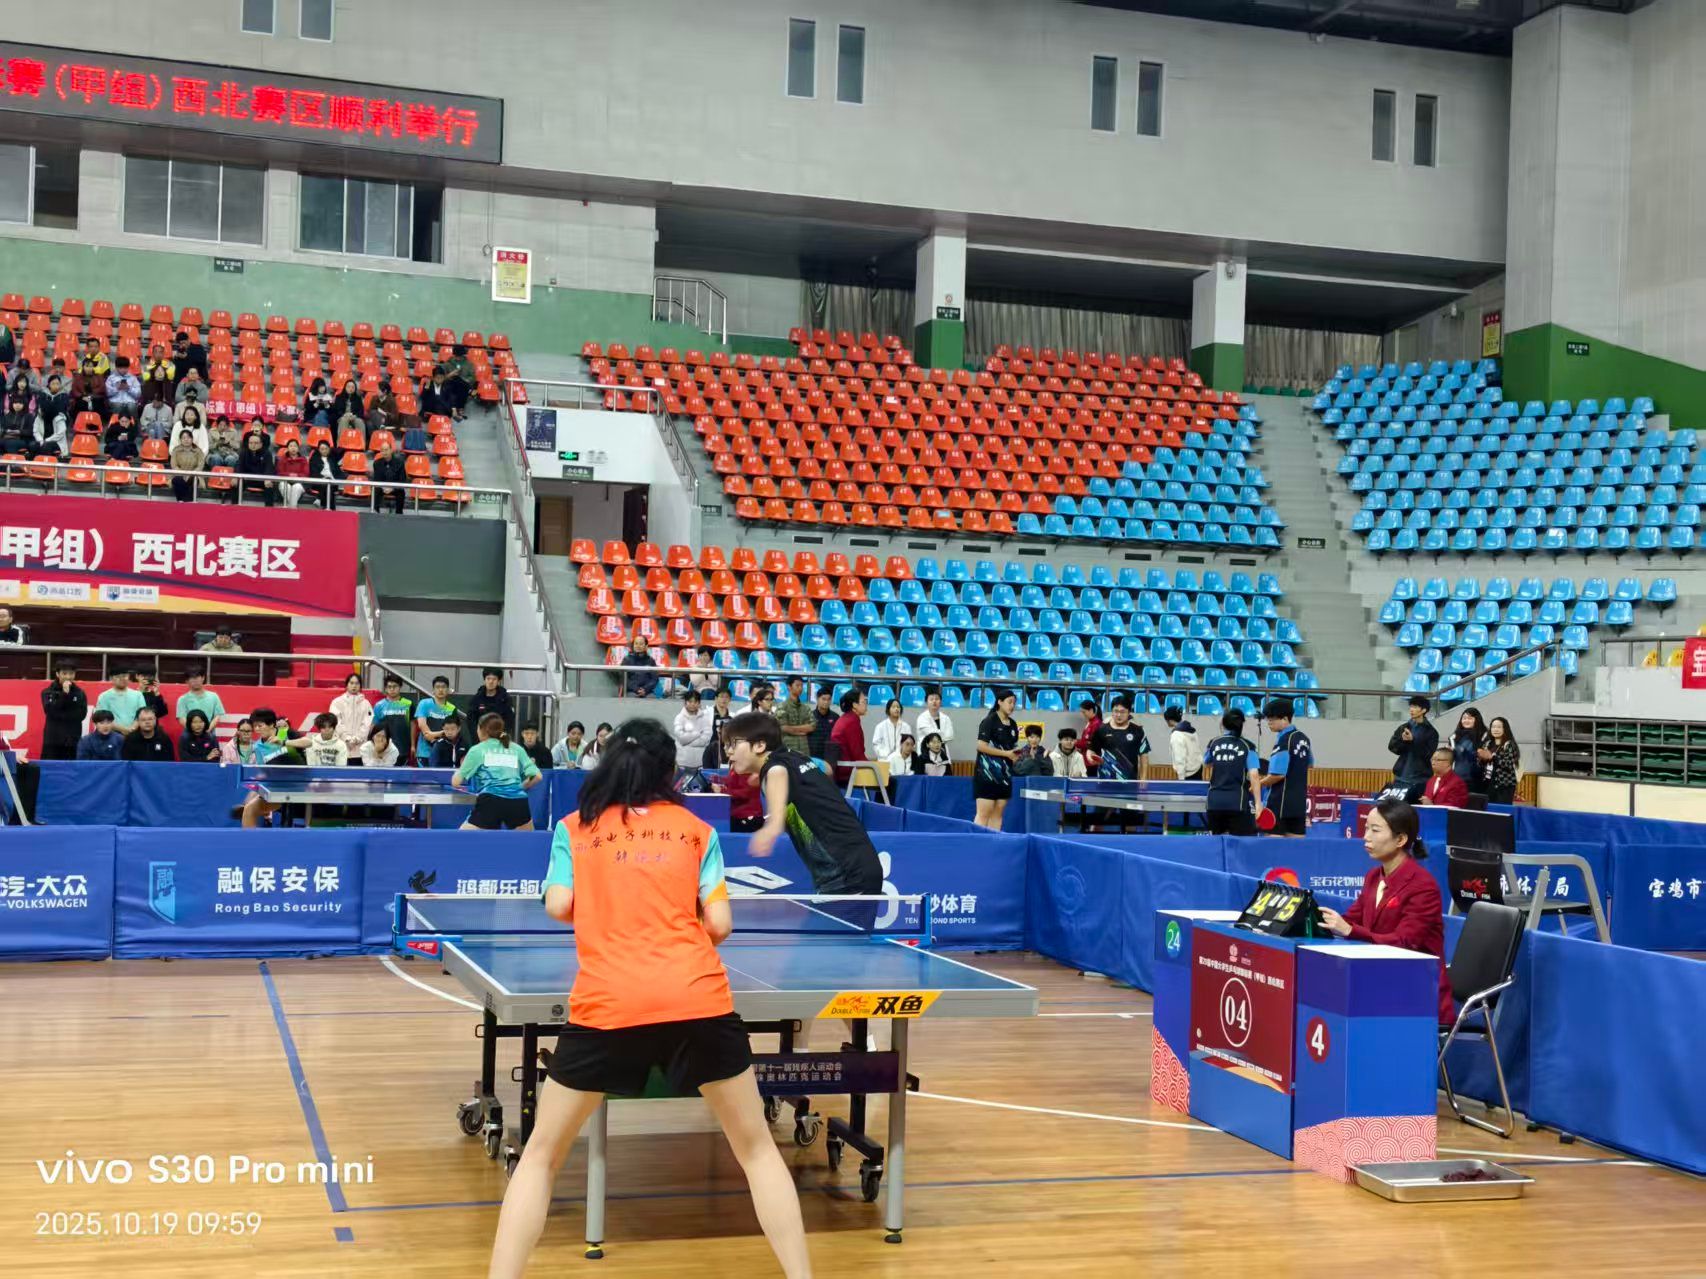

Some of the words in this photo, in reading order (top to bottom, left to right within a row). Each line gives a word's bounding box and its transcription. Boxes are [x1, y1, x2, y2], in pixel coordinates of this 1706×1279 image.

[0, 58, 479, 147] 赛（甲组）西北赛区顺利举行
[217, 866, 340, 893] 融保安保
[215, 903, 250, 915] Rong
[253, 903, 280, 913] Bao
[282, 901, 342, 914] Security
[1167, 928, 1181, 952] 24
[872, 995, 923, 1015] 双鱼
[1225, 995, 1248, 1031] 04
[1310, 1022, 1326, 1056] 4
